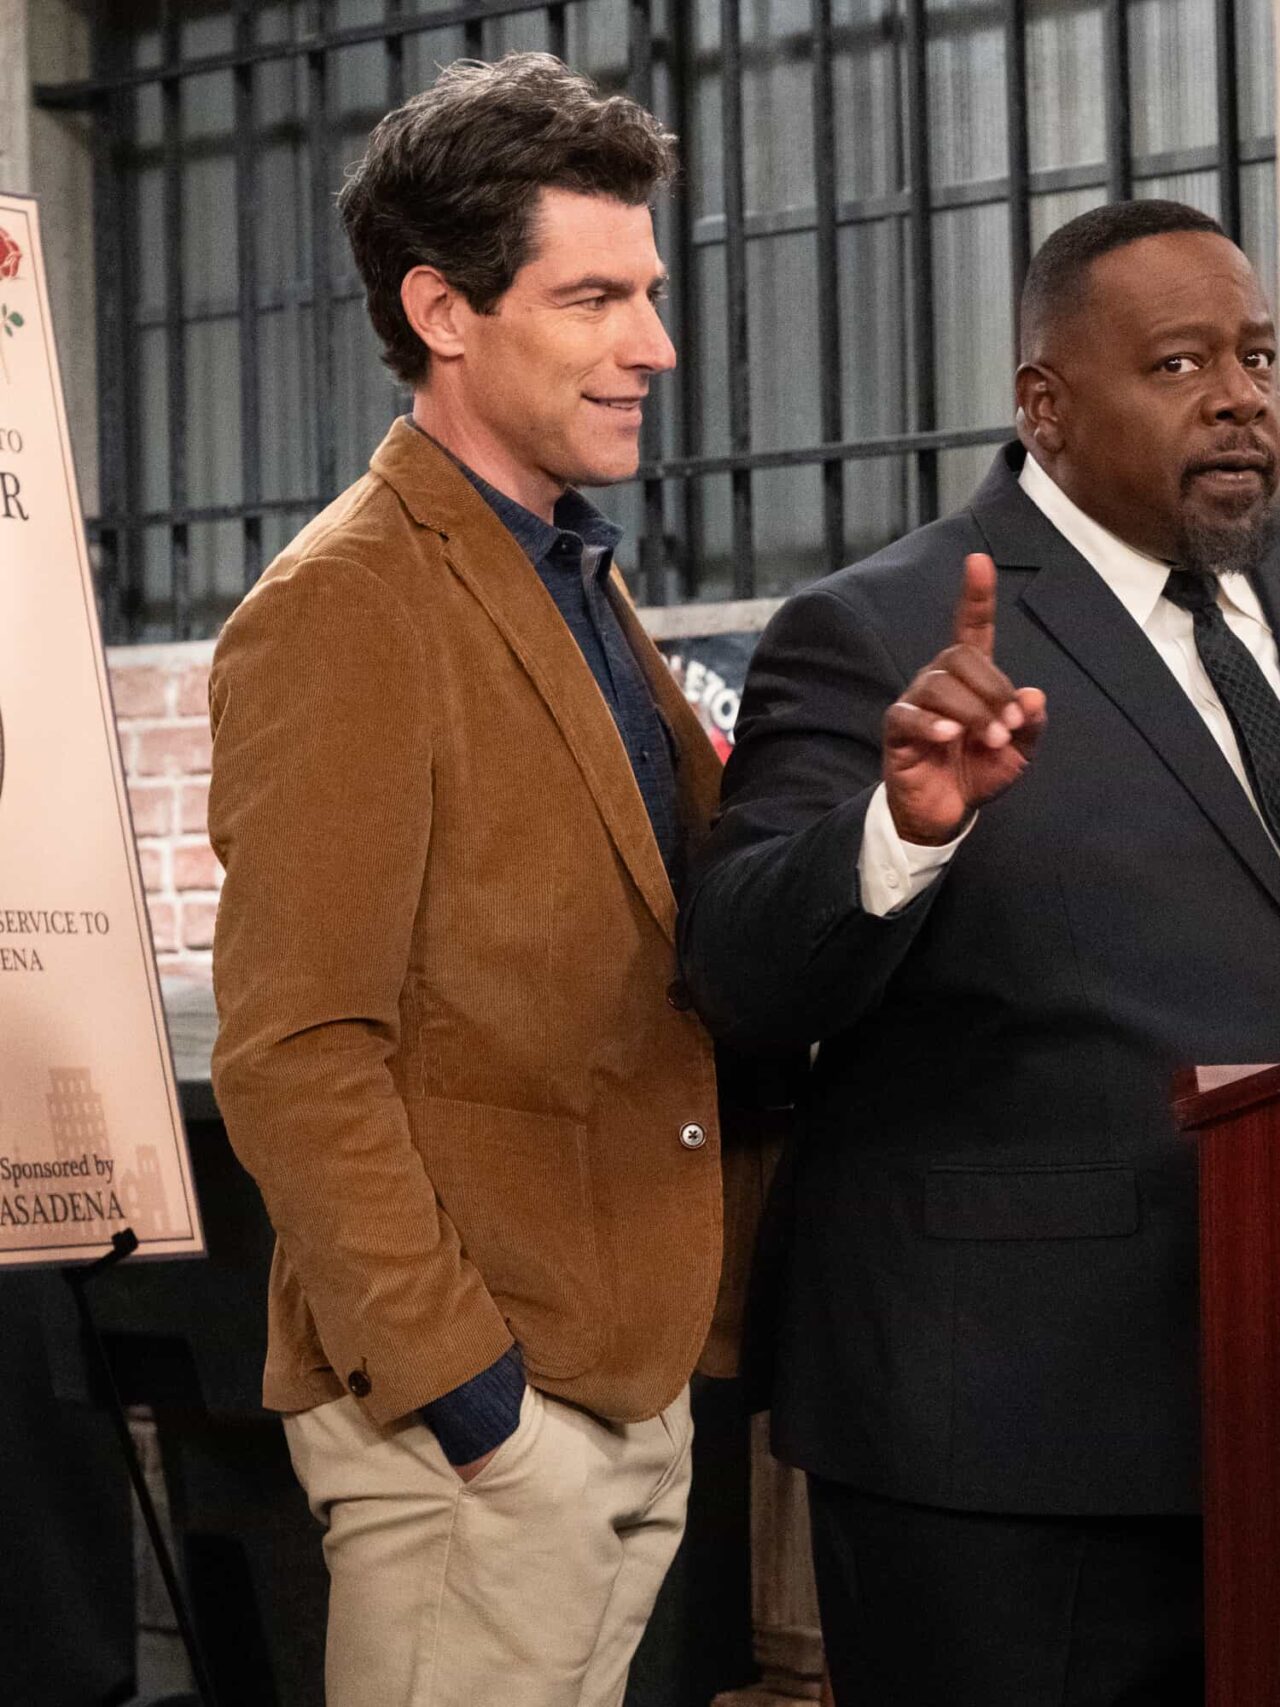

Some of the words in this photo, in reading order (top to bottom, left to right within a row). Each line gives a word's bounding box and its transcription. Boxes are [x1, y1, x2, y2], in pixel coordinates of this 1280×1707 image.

[79, 911, 110, 935] TO
[0, 1154, 91, 1188] Sponsored
[93, 1153, 114, 1184] by
[0, 1190, 126, 1226] ASADENA
